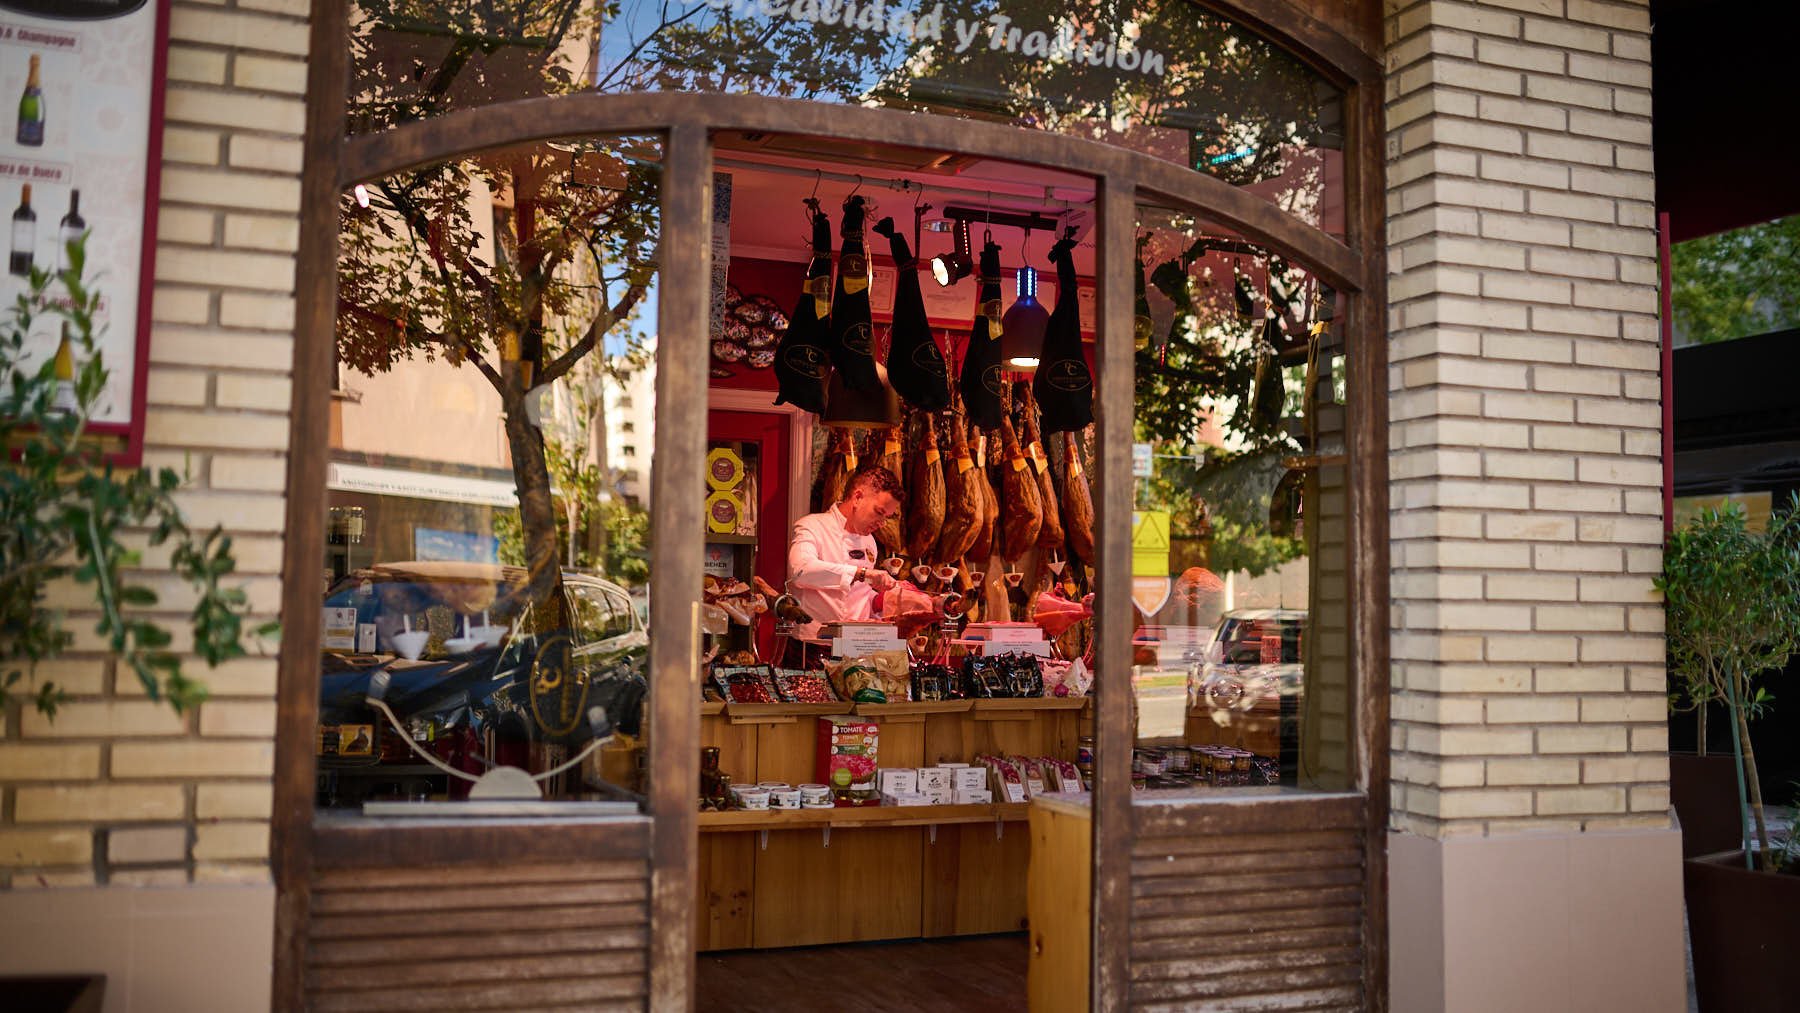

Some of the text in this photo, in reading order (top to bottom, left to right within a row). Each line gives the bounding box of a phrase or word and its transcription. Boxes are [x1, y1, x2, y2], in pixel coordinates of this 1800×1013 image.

[954, 18, 979, 53] y
[988, 13, 1165, 76] Tradición
[840, 726, 862, 734] TOMATE
